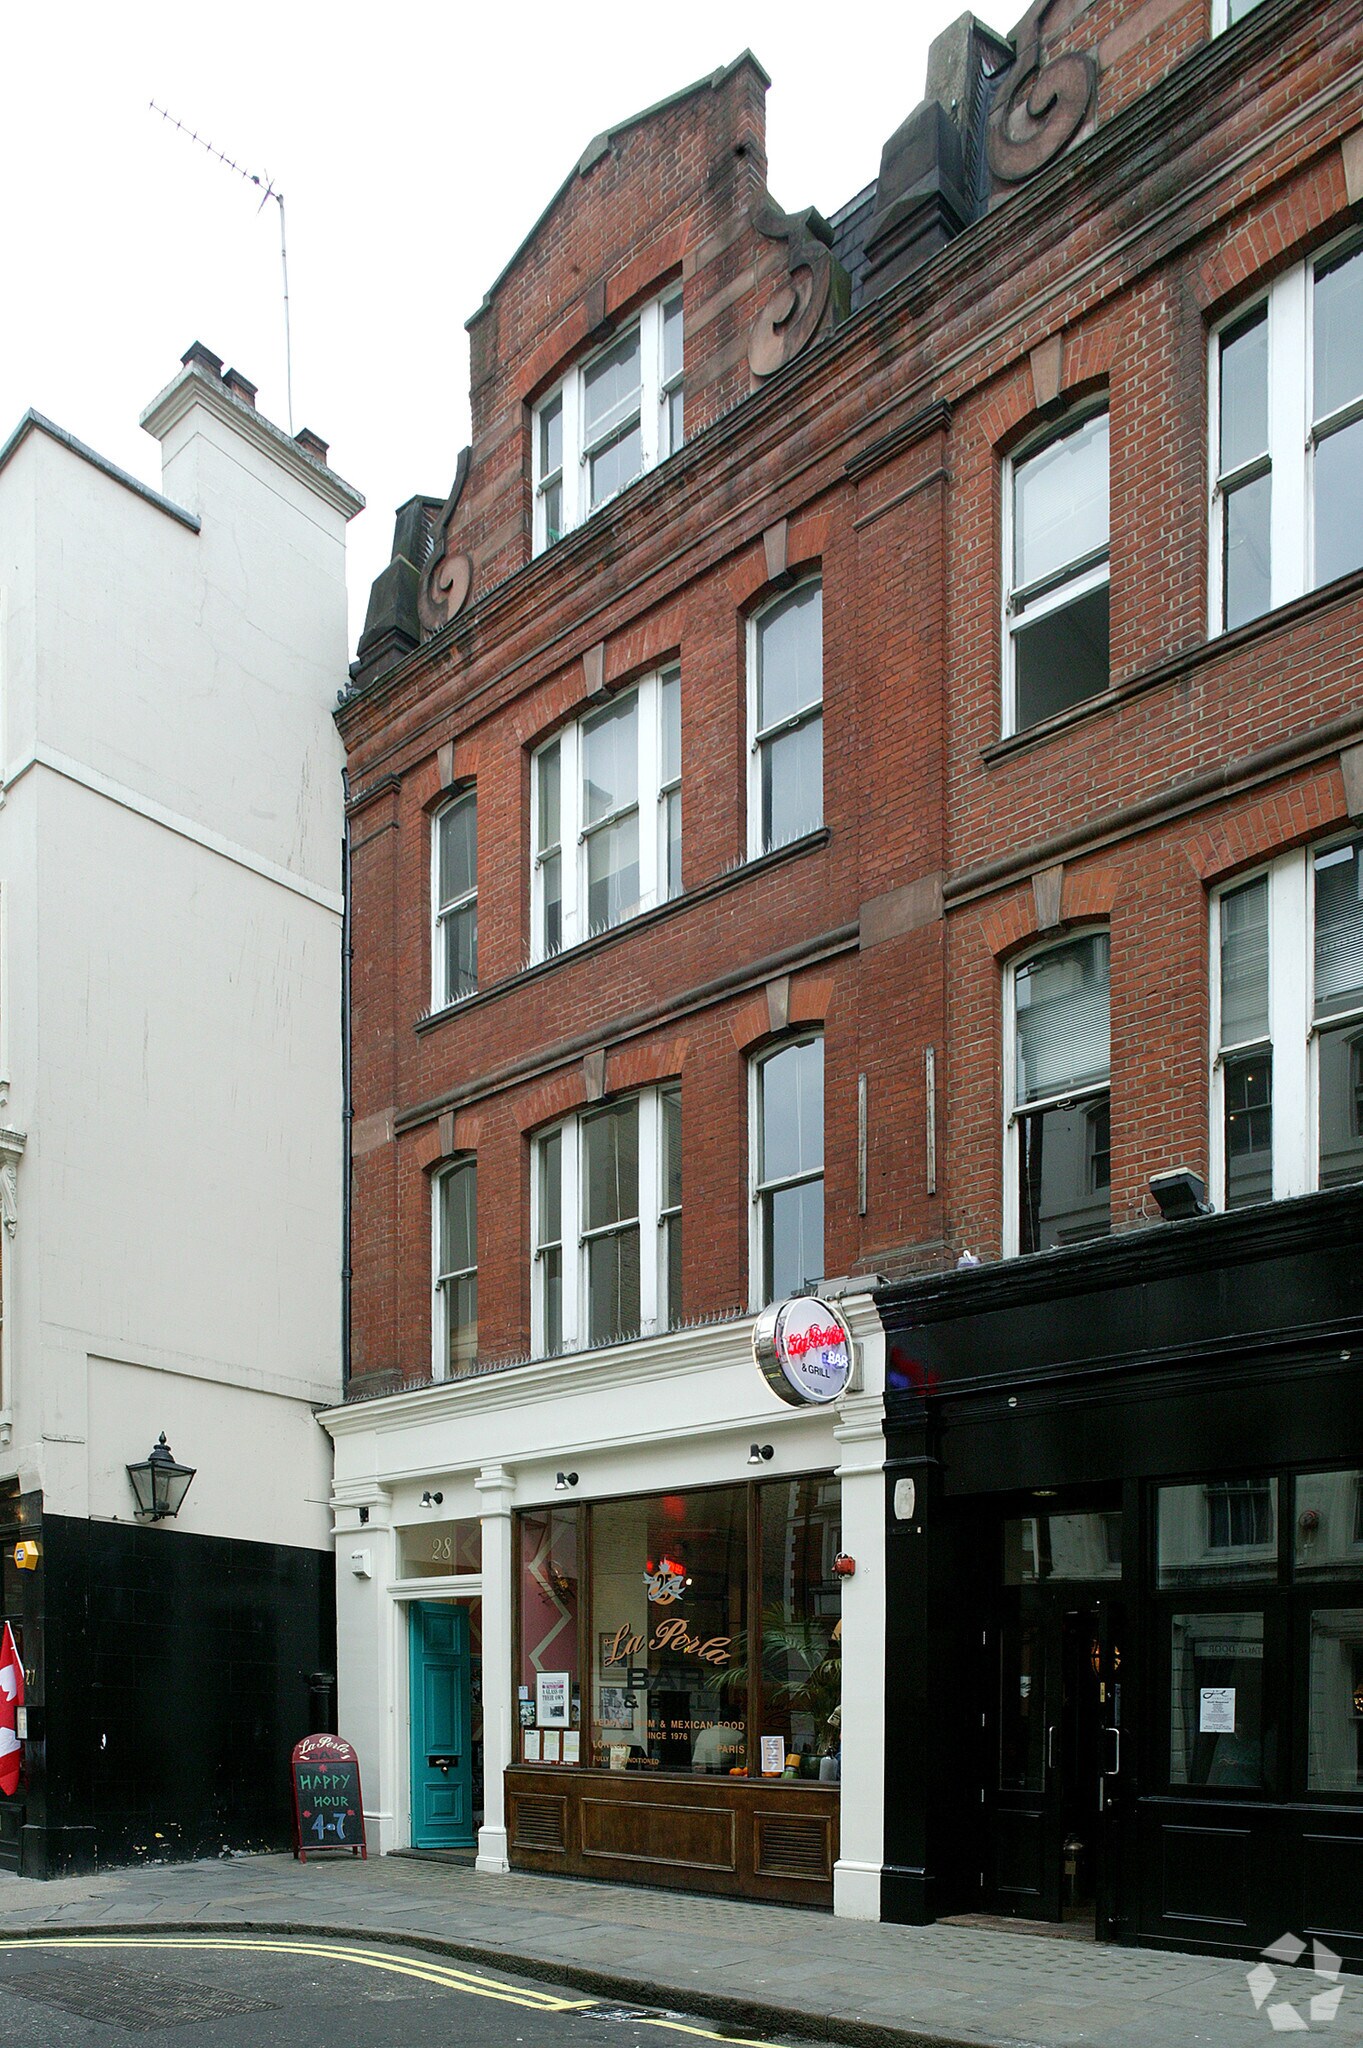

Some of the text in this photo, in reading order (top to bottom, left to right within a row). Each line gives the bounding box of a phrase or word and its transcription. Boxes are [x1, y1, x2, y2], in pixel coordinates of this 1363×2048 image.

[825, 1351, 849, 1370] BAR
[801, 1363, 831, 1379] & GRILL
[432, 1537, 452, 1560] 28
[604, 1618, 732, 1667] La Perla
[627, 1668, 705, 1690] BAR
[624, 1694, 639, 1709] &
[660, 1720, 666, 1729] &
[671, 1720, 713, 1729] MEXICAN
[717, 1721, 745, 1731] FOOD
[299, 1736, 350, 1755] La Perla
[717, 1745, 745, 1754] PARIS
[300, 1774, 350, 1789] HAPPY
[313, 1796, 349, 1807] HOUR
